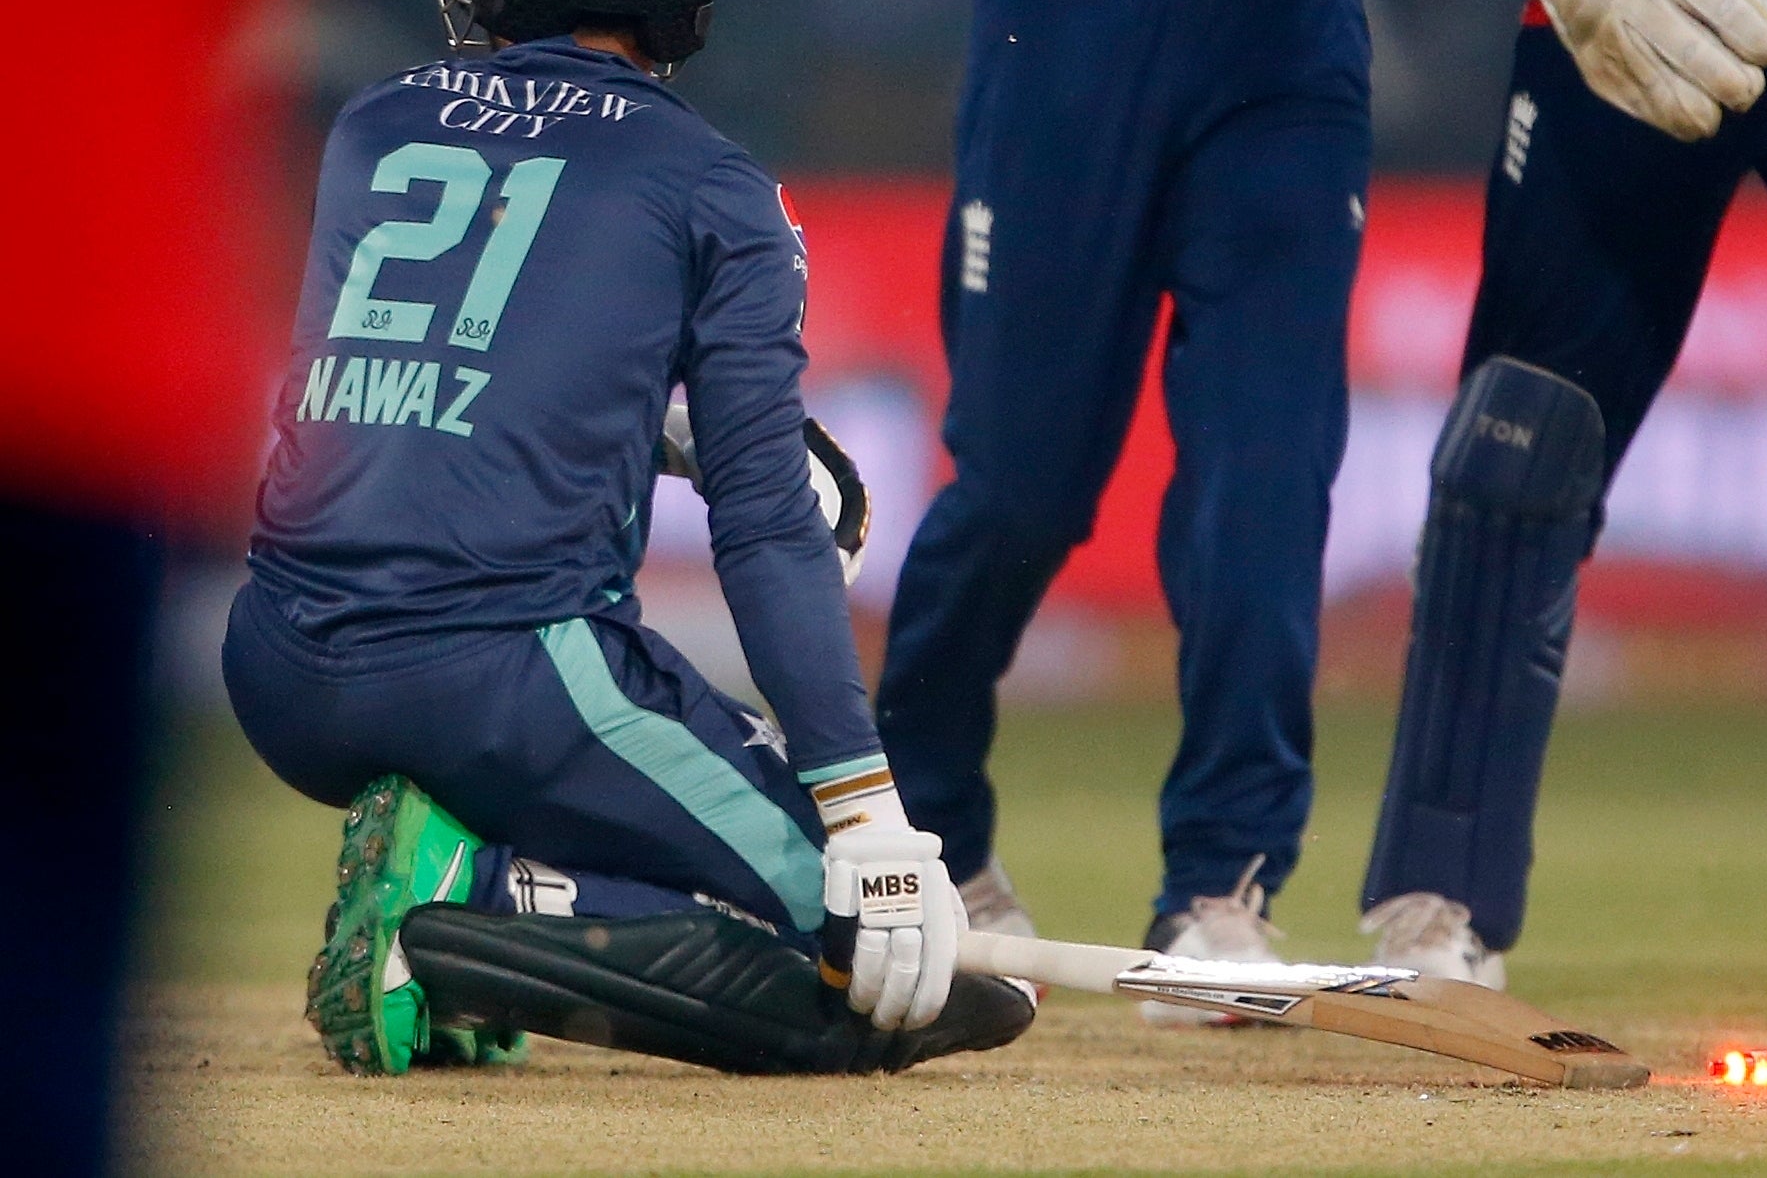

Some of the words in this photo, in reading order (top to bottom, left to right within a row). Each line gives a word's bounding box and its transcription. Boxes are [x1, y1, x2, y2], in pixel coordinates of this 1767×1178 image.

[439, 98, 565, 138] CITY
[328, 142, 567, 352] 21
[296, 356, 491, 438] NAWAZ
[1477, 413, 1534, 450] TON
[862, 873, 919, 898] MBS
